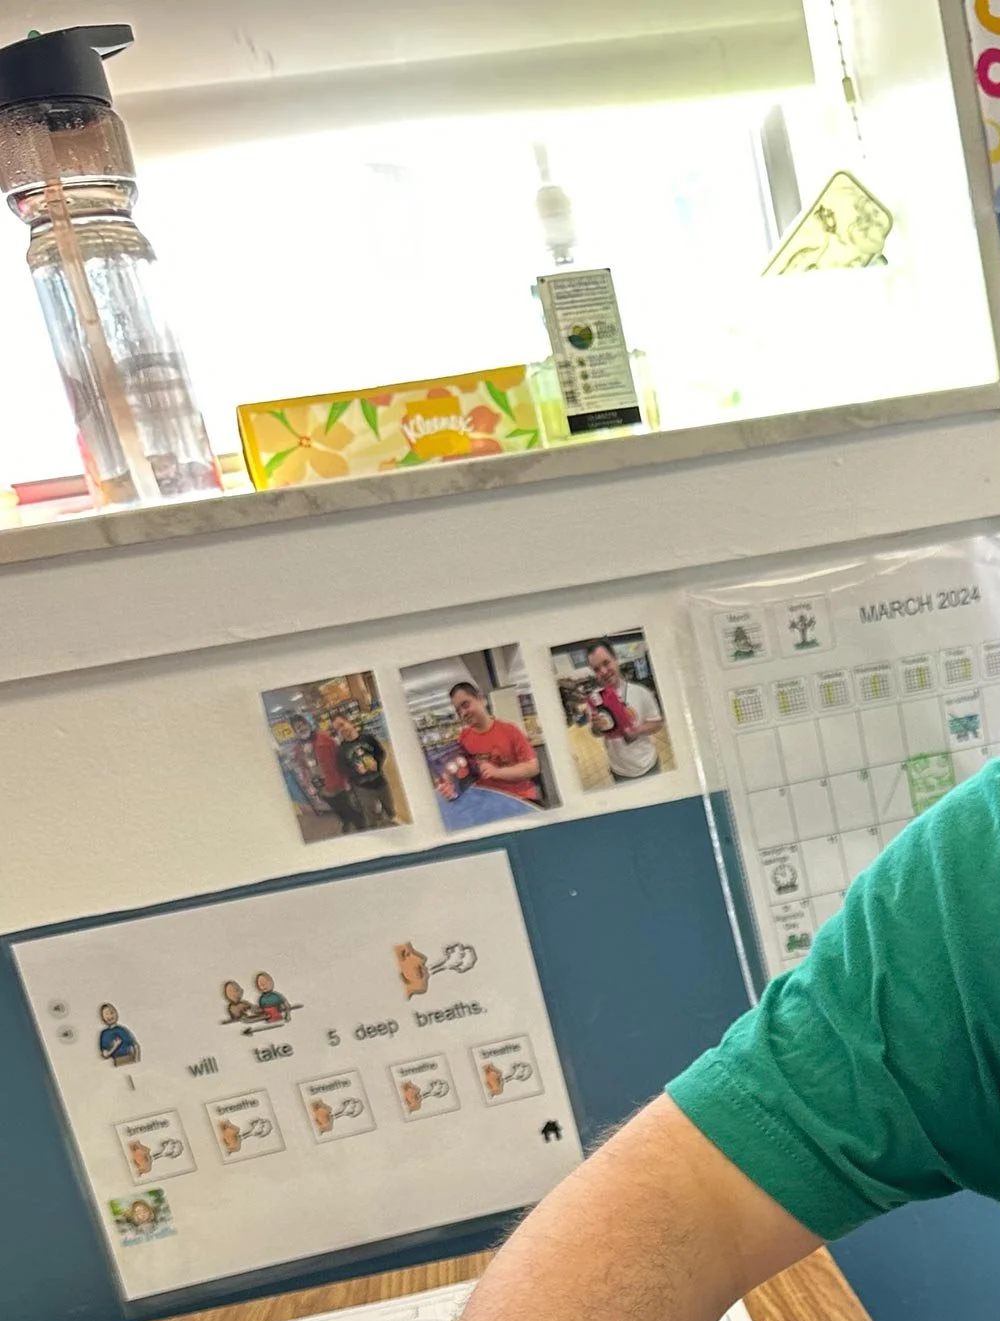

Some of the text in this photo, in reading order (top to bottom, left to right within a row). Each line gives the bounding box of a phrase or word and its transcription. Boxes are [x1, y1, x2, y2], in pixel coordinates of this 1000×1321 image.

[403, 413, 474, 444] Kleenex
[859, 585, 982, 624] MARCH 2024
[187, 1056, 219, 1078] will
[253, 1042, 295, 1064] take
[327, 1027, 341, 1047] 5
[354, 1018, 399, 1041] deep
[413, 1000, 488, 1028] breaths.
[482, 1043, 522, 1060] breathe
[397, 1061, 439, 1077] breathe
[309, 1078, 352, 1096] breathe
[216, 1098, 260, 1116] breathe
[126, 1118, 170, 1137] breathe
